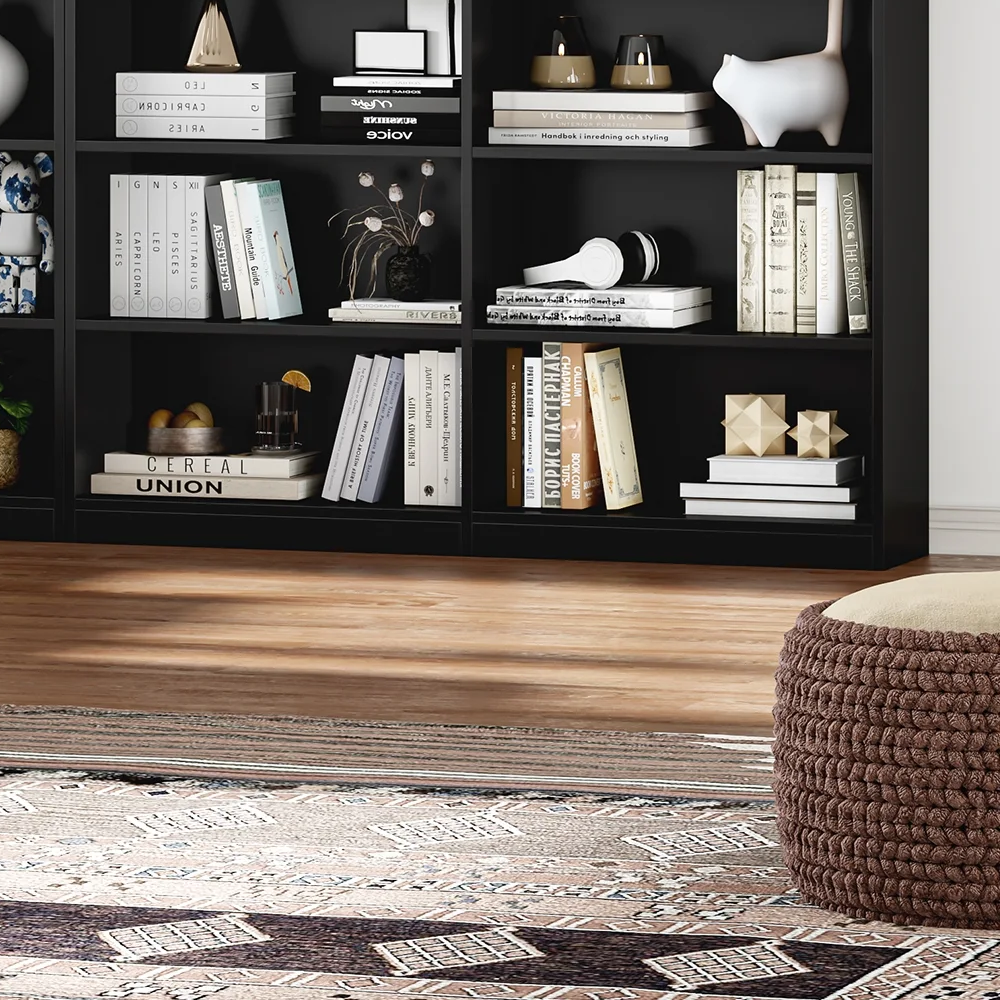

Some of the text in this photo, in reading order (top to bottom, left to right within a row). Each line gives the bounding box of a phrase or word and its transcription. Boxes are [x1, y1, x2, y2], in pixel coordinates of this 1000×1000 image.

[541, 112, 653, 121] VICTORIA HAGAN
[541, 132, 577, 140] Handbok
[584, 133, 623, 142] inredning
[642, 134, 669, 143] styling
[134, 181, 141, 189] G
[172, 182, 178, 190] S
[188, 182, 199, 190] XII
[115, 232, 123, 267] ARIES
[152, 232, 160, 253] LEO
[171, 233, 179, 275] PISCES
[190, 211, 198, 290] SAGITTARIUS
[213, 223, 232, 292] AESTHETE
[244, 227, 260, 287] Mountain Guide
[842, 191, 862, 302] YOUNG THE SHACK
[406, 311, 458, 320] RIVERS
[425, 366, 433, 429] ДАНТЕ АЛИГЬЕРИ
[560, 355, 571, 407] CHAPMAN
[573, 366, 582, 397] CALLUM
[544, 350, 561, 499] БОРИС ПАСТЕРНАК
[147, 456, 248, 475] CEREAL
[571, 452, 580, 500] BOOK COVER
[136, 478, 223, 495] UNION
